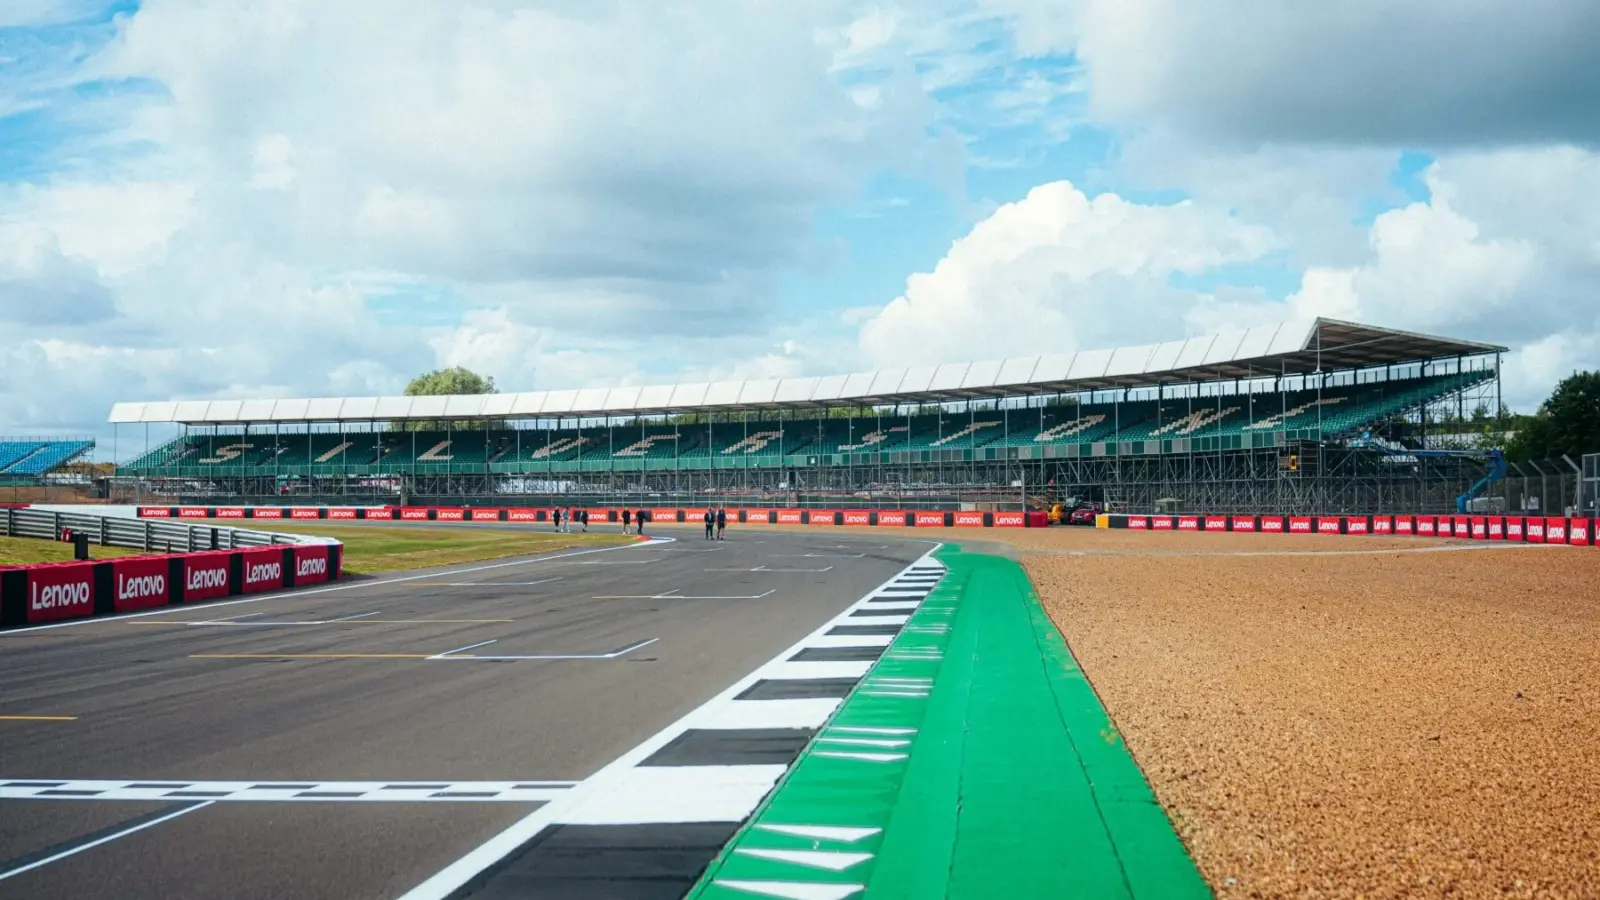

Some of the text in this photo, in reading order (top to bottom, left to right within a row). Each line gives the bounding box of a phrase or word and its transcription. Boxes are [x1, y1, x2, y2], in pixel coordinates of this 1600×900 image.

[143, 509, 168, 517] Lenovo
[181, 509, 206, 517] Lenovo
[218, 509, 243, 517] Lenovo
[256, 510, 281, 518] Lenovo
[293, 510, 318, 518] Lenovo
[367, 511, 391, 519] Lenovo
[510, 512, 535, 520] Lenovo
[654, 513, 676, 521] Lenovo
[779, 514, 800, 522] Lenovo
[811, 515, 833, 523] Lenovo
[917, 516, 943, 524] Lenovo
[956, 516, 982, 524] Lenovo
[996, 517, 1023, 525] Lenovo
[297, 557, 326, 576] Lenovo
[246, 562, 281, 583] Lenovo
[187, 567, 226, 590] Lenovo
[119, 574, 164, 599] Lenovo
[32, 581, 90, 610] Lenovo
